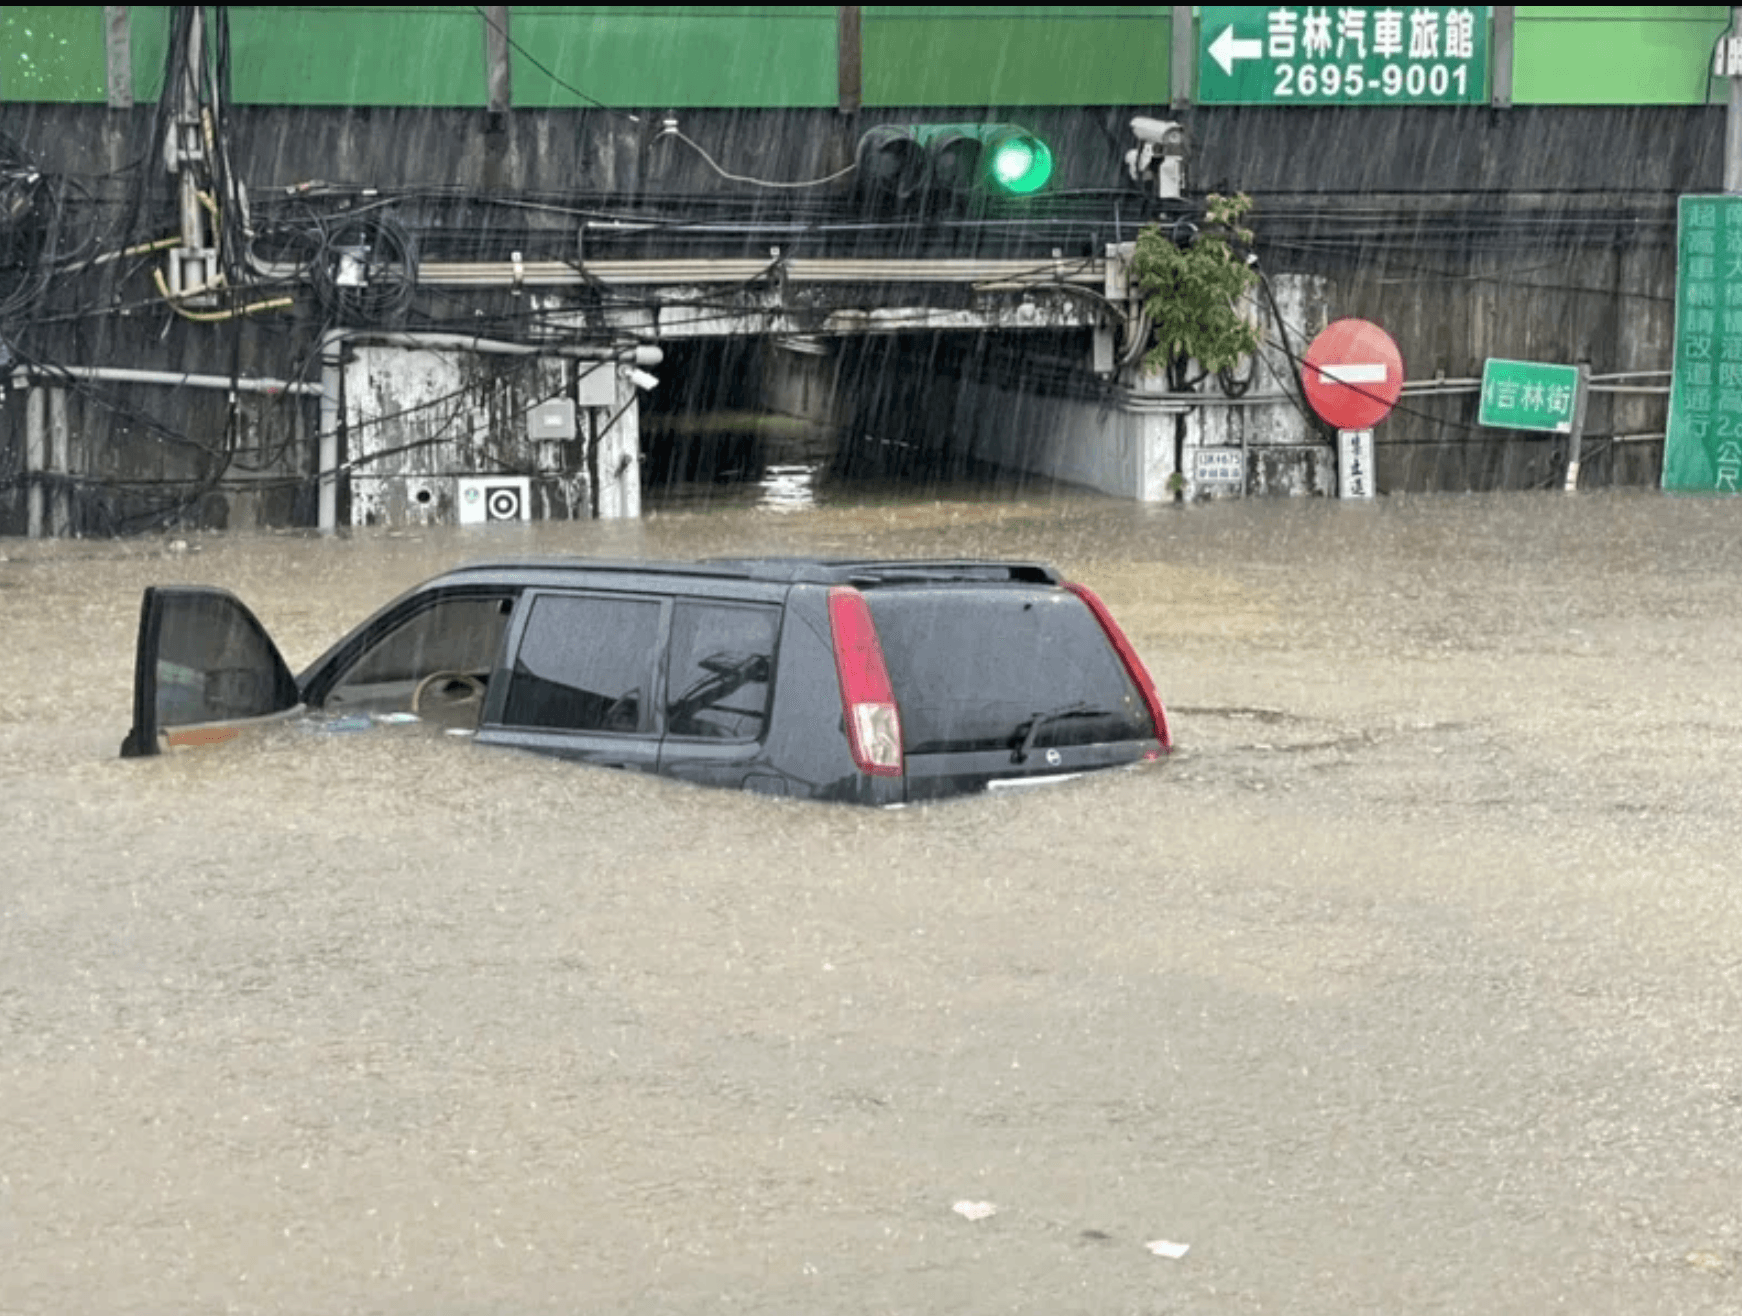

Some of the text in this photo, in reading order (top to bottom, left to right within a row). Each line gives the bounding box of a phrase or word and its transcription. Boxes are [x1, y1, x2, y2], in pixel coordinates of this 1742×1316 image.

[1267, 7, 1475, 60] 吉林汽車旅館
[1272, 63, 1468, 96] 2695-9001
[1495, 376, 1571, 414] 吉林街
